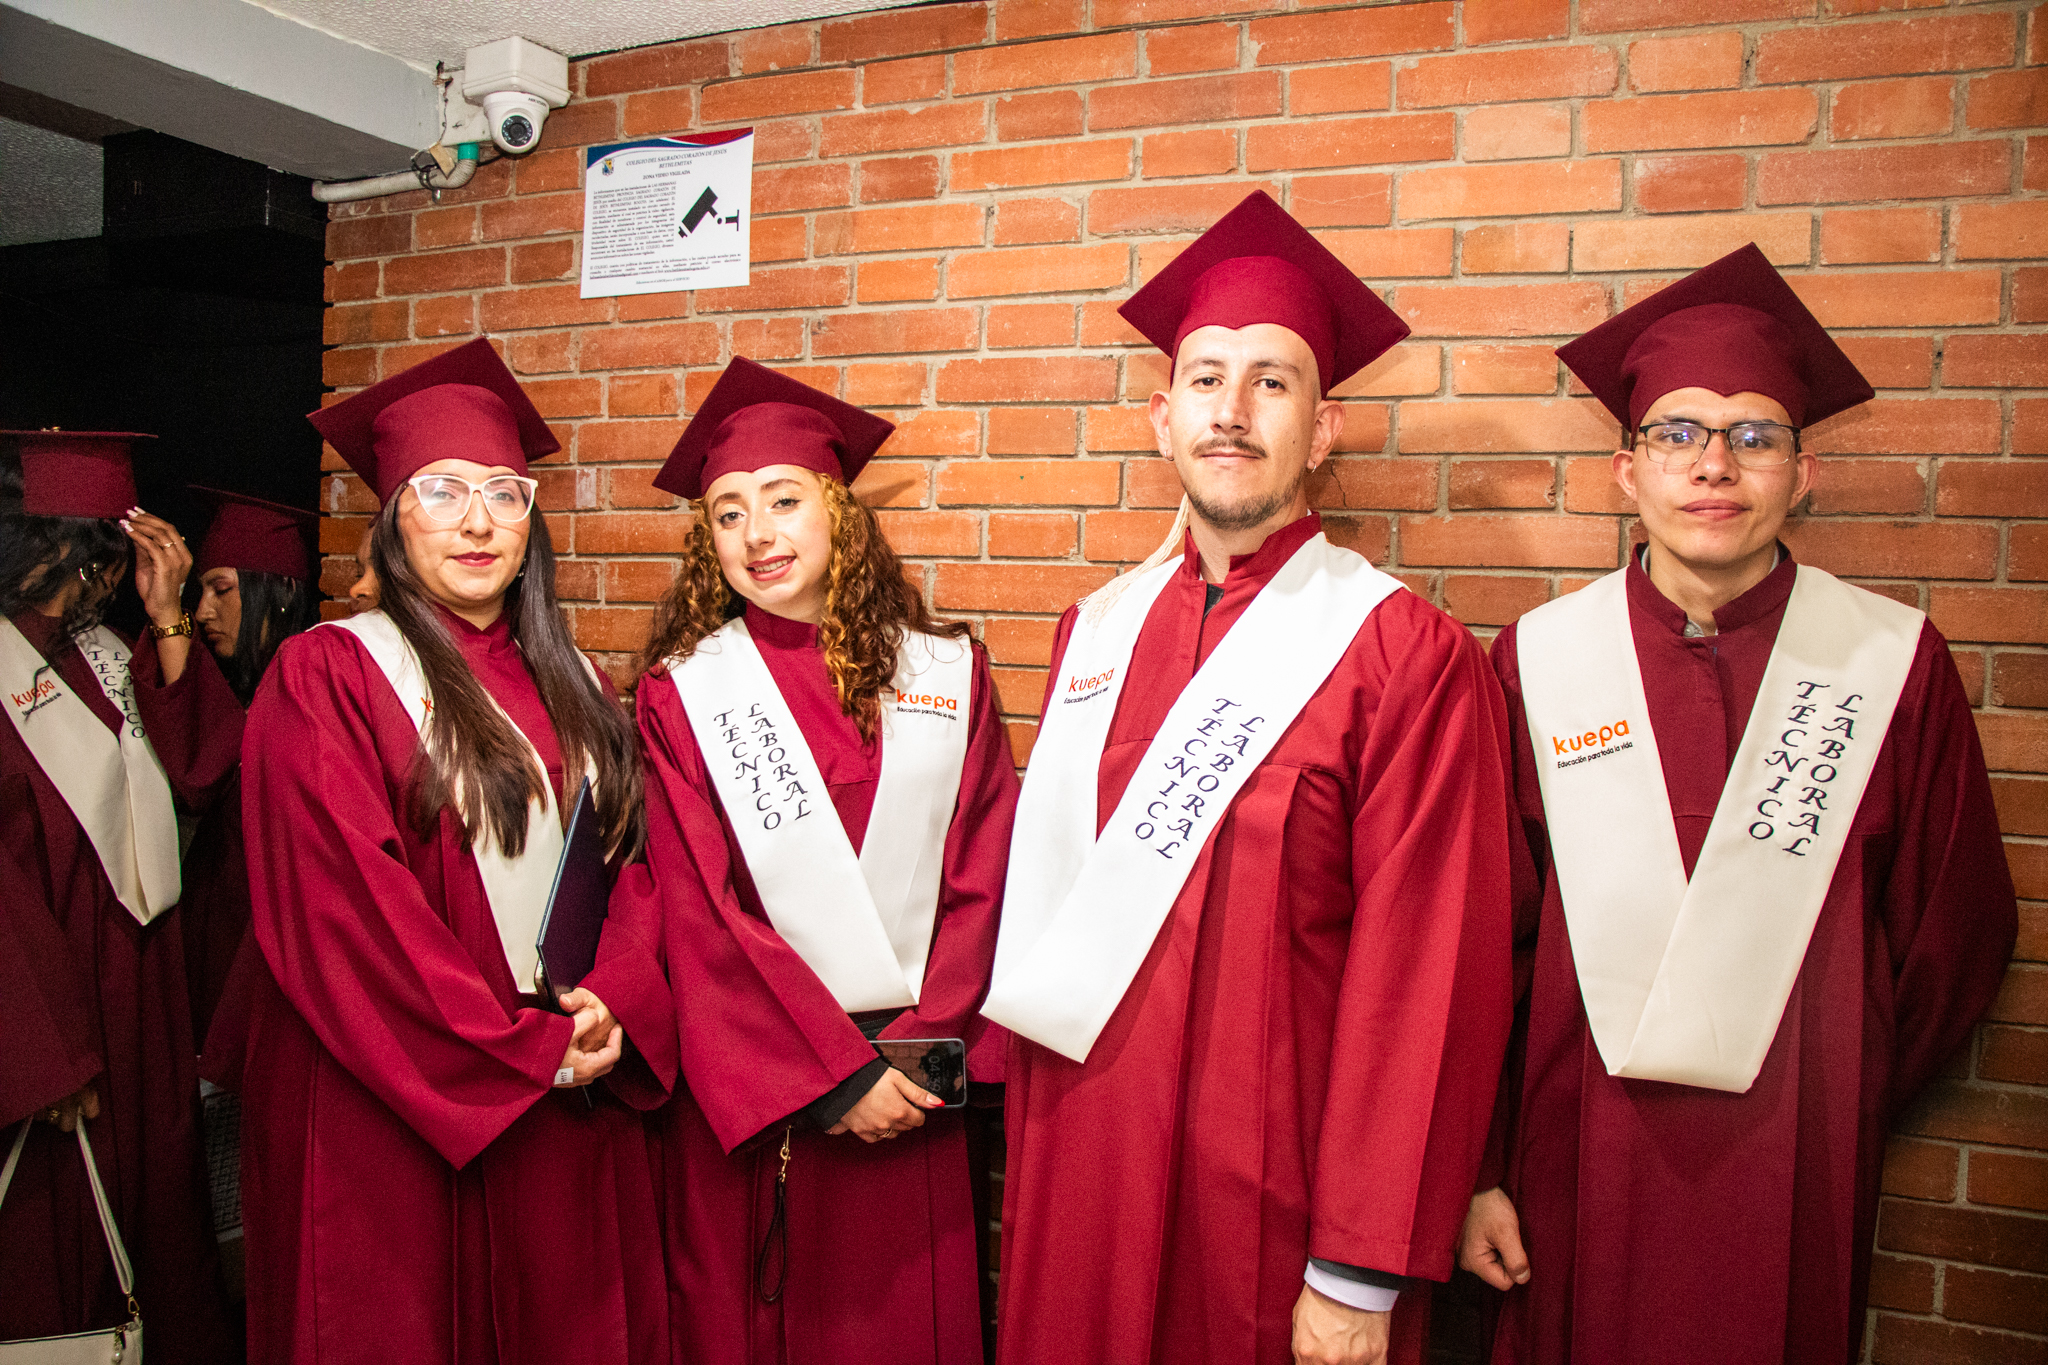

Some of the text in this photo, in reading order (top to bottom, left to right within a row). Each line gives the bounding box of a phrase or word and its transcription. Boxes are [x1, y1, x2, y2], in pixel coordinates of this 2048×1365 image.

[658, 160, 693, 168] BETHLEMITAS
[11, 679, 56, 707] kuepa
[87, 649, 146, 739] TÉCNICO
[896, 688, 957, 711] kuepa
[1068, 668, 1115, 692] kuepa
[714, 708, 782, 830] TÉCNICO
[748, 703, 812, 820] LABORAL
[1134, 698, 1242, 840] TÉCNICO
[1552, 719, 1630, 756] kuepa
[1557, 755, 1587, 769] Educación
[1588, 752, 1601, 762] para
[1601, 747, 1614, 756] toda
[1620, 741, 1634, 750] vida
[1748, 680, 1831, 840] TÉCNICO
[1782, 694, 1863, 857] LABORAL
[1156, 716, 1265, 859] LABORAL
